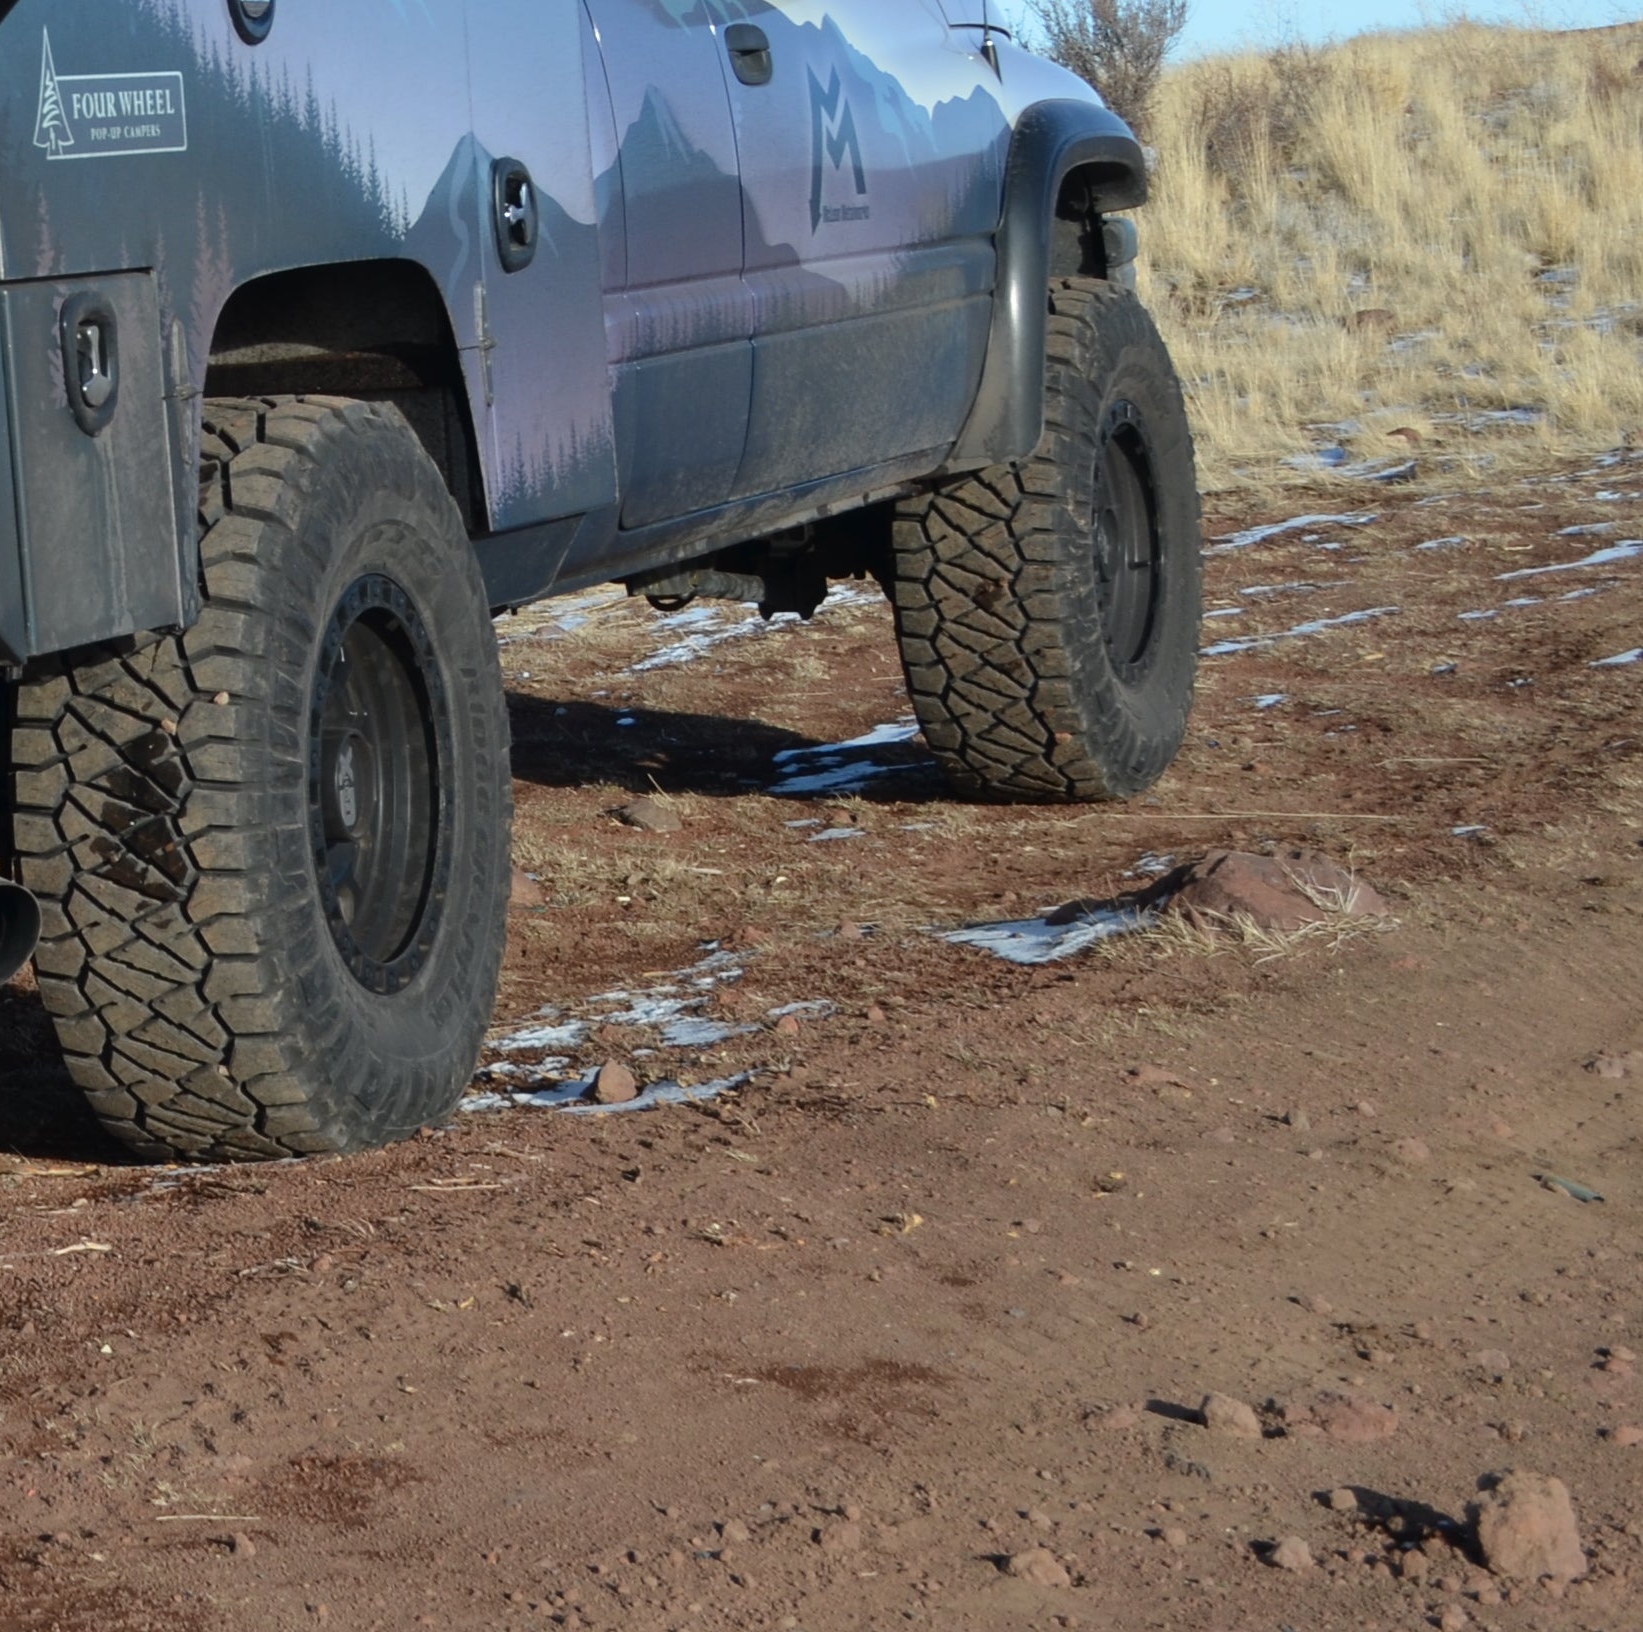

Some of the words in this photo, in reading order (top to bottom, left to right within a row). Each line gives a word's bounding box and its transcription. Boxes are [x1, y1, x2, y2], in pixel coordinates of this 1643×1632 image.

[72, 92, 118, 119] FOUR
[118, 89, 175, 117] WHEEL
[90, 126, 122, 141] POP-UP
[123, 124, 161, 139] CAMPERS
